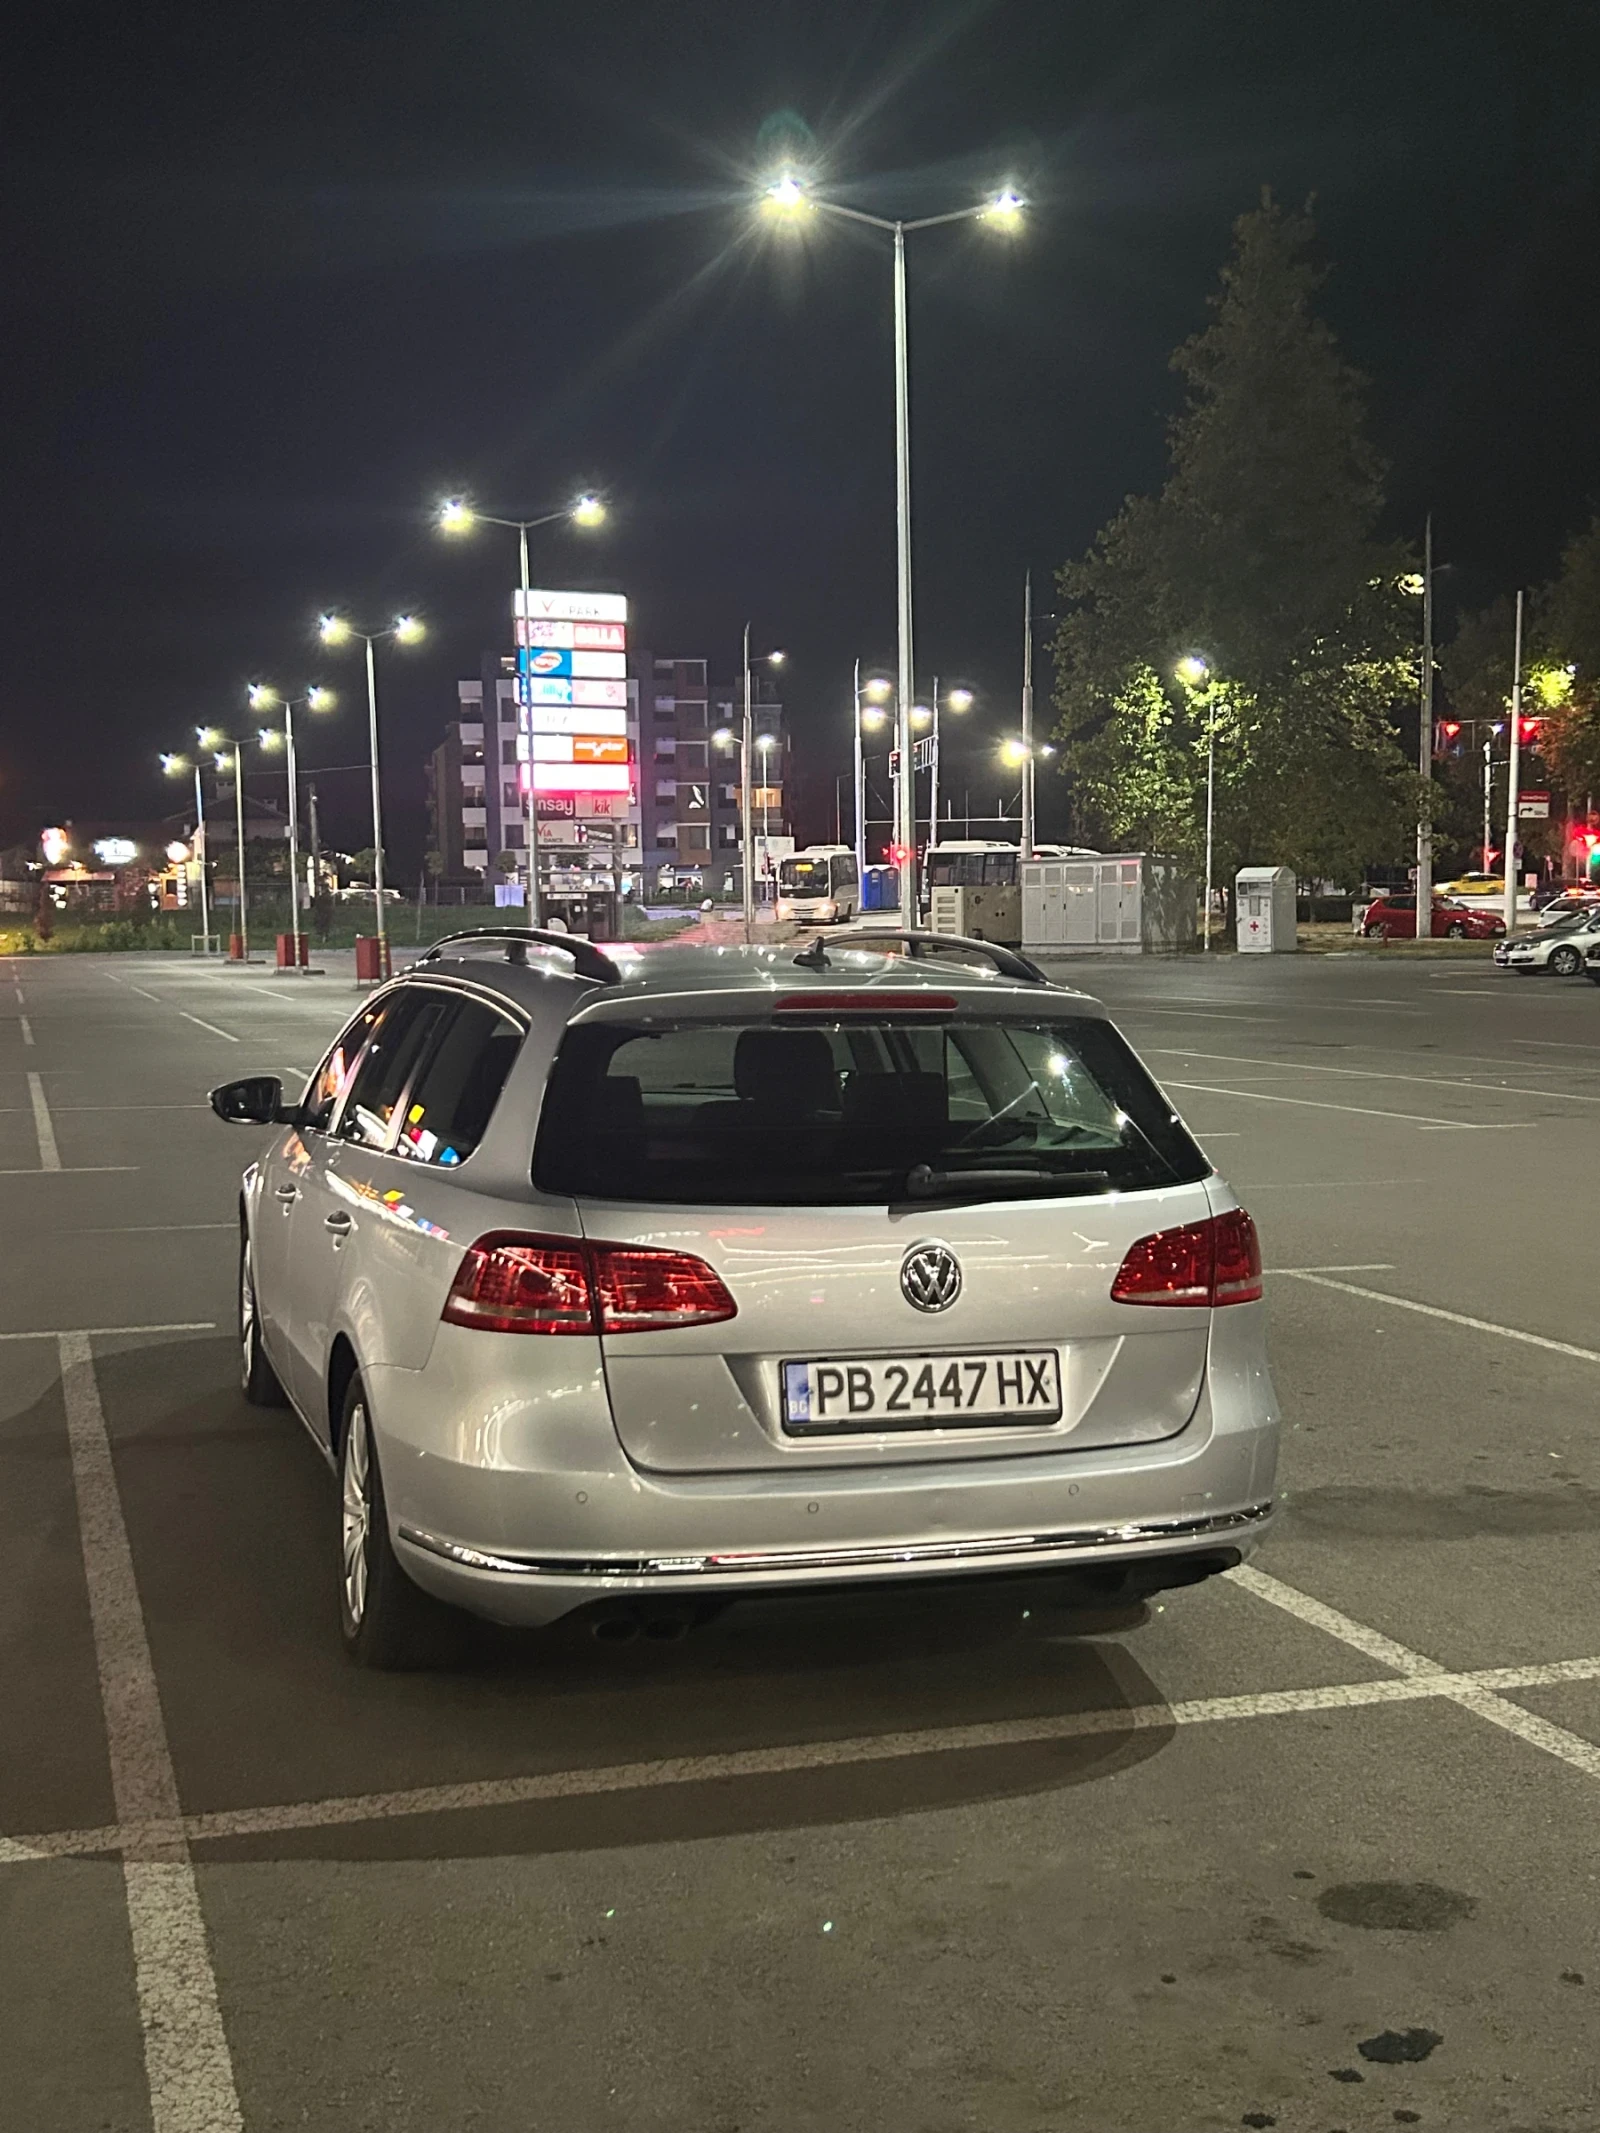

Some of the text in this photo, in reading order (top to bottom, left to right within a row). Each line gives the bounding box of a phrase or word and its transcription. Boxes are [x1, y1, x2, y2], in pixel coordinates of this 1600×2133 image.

[816, 1359, 1051, 1415] PB 2447 HX
[789, 1400, 808, 1414] BG
